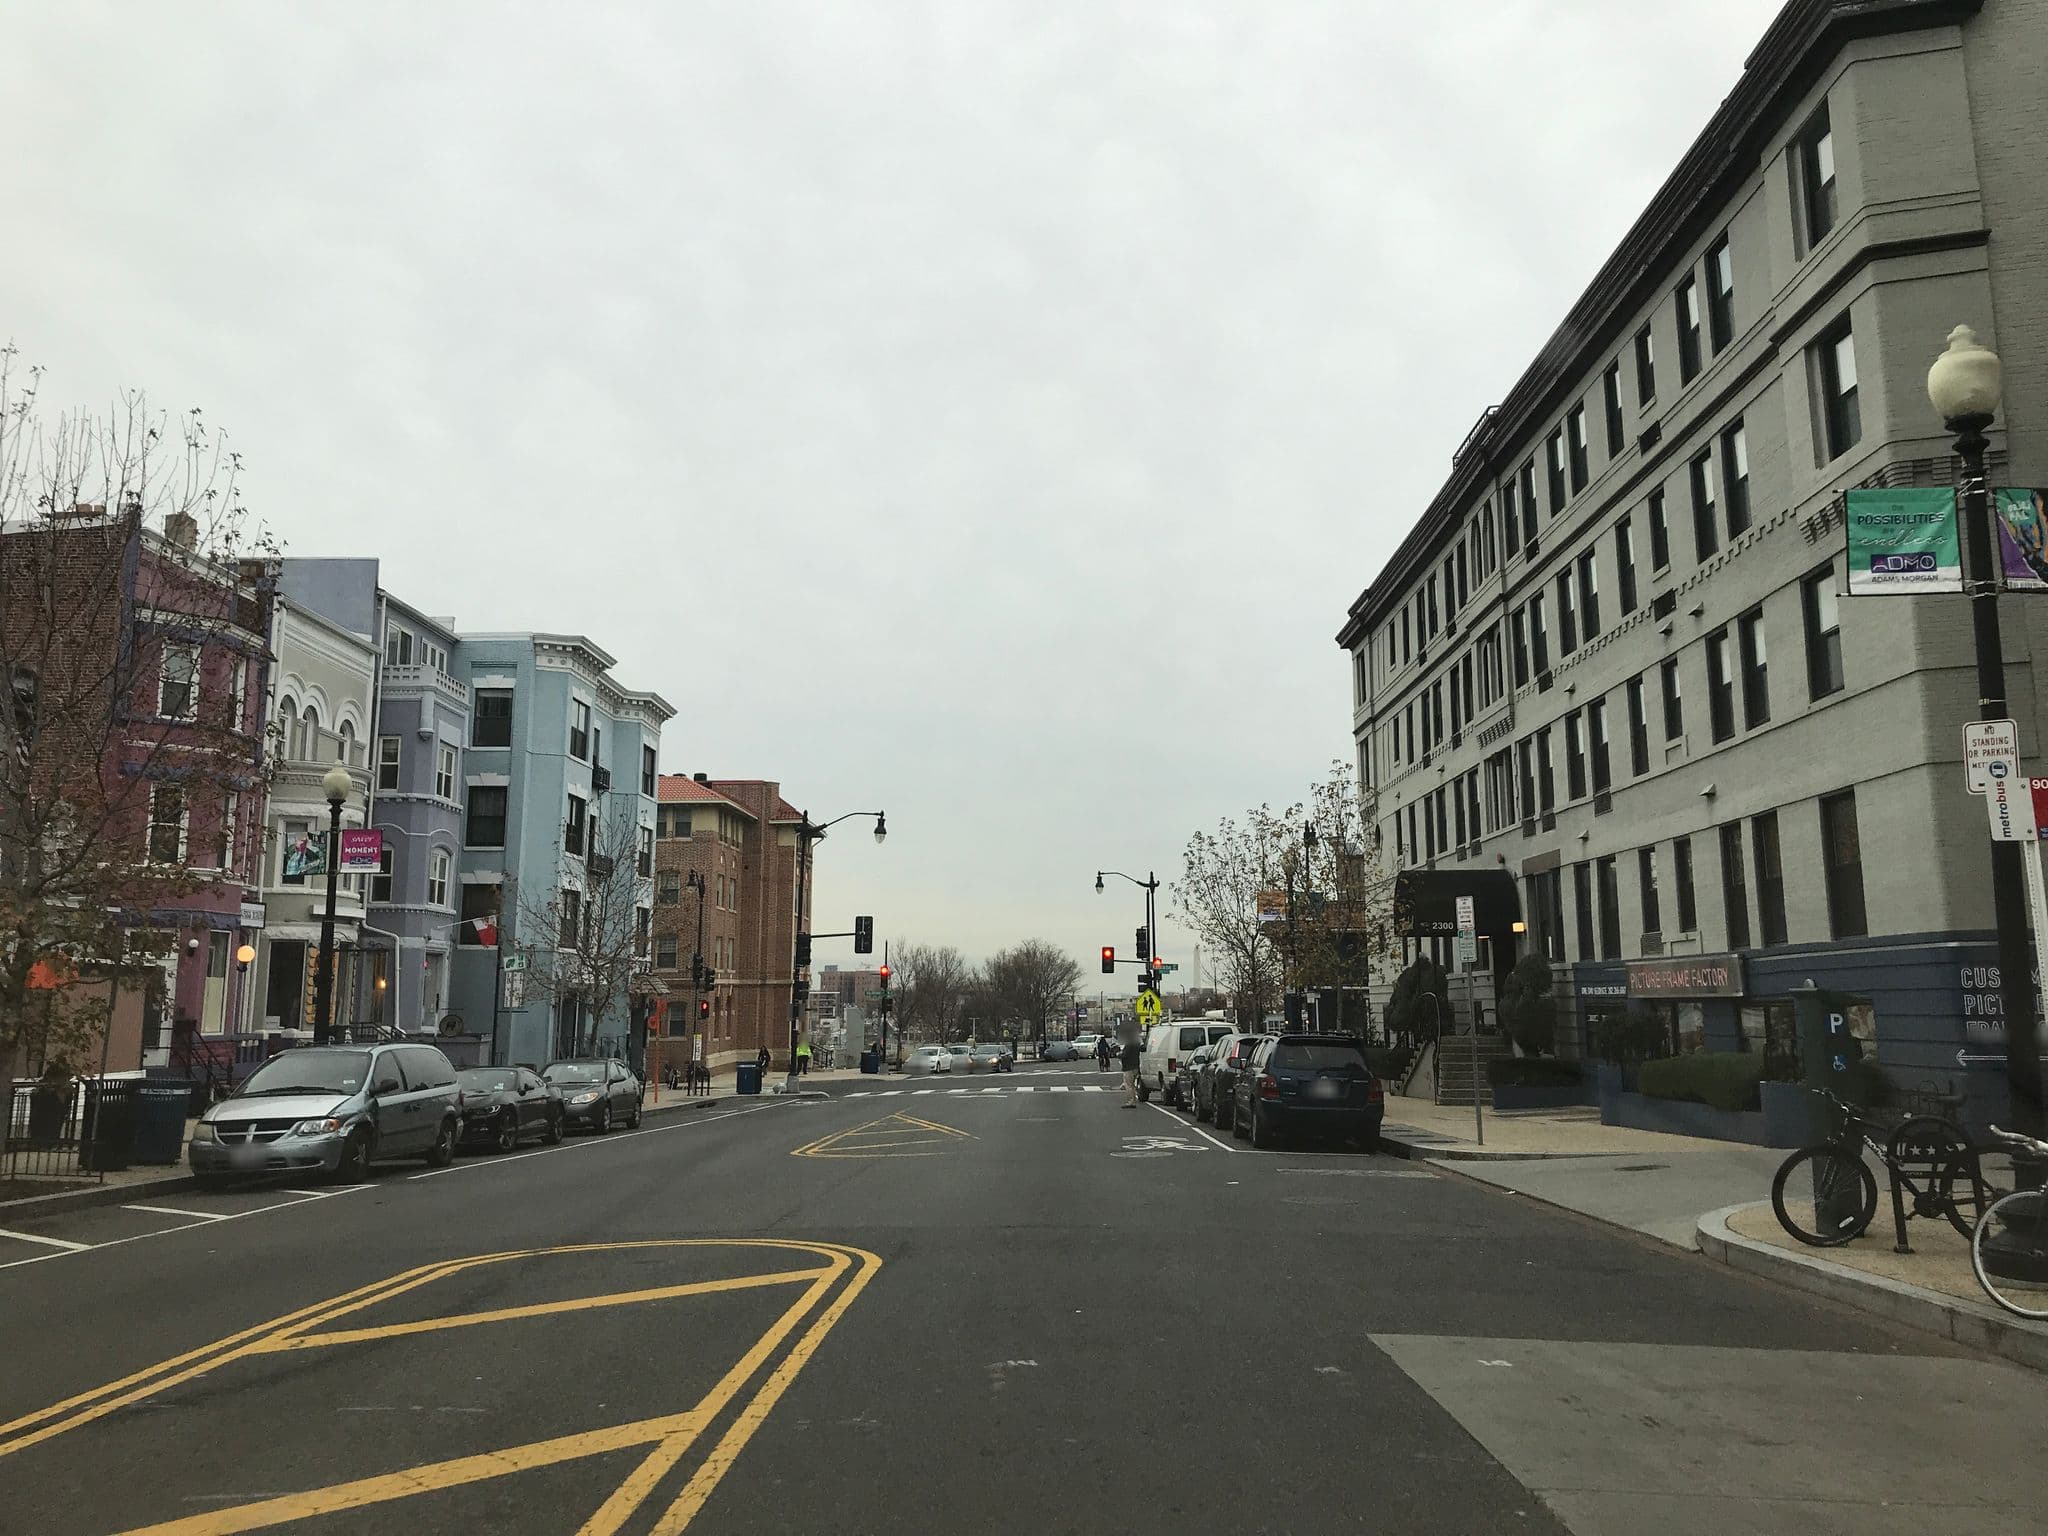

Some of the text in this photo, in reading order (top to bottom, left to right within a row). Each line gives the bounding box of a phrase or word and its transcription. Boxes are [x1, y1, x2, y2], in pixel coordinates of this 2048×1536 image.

[1857, 512, 1945, 526] POSSIBILITIES
[1860, 528, 1948, 546] endless
[1872, 555, 1936, 571] ADMO
[1871, 573, 1939, 584] ADAMS MORGAN
[1984, 725, 1995, 735] NO
[1972, 736, 2010, 748] STANDING
[1968, 748, 2015, 759] OR PARKING
[1996, 781, 2012, 837] metrobus
[344, 846, 378, 854] MOMENT
[1432, 921, 1454, 930] 2300
[1630, 971, 1661, 990] PICTURE
[1663, 970, 1691, 989] FRAME
[1692, 967, 1729, 987] FACTORY
[1830, 1013, 1844, 1034] P
